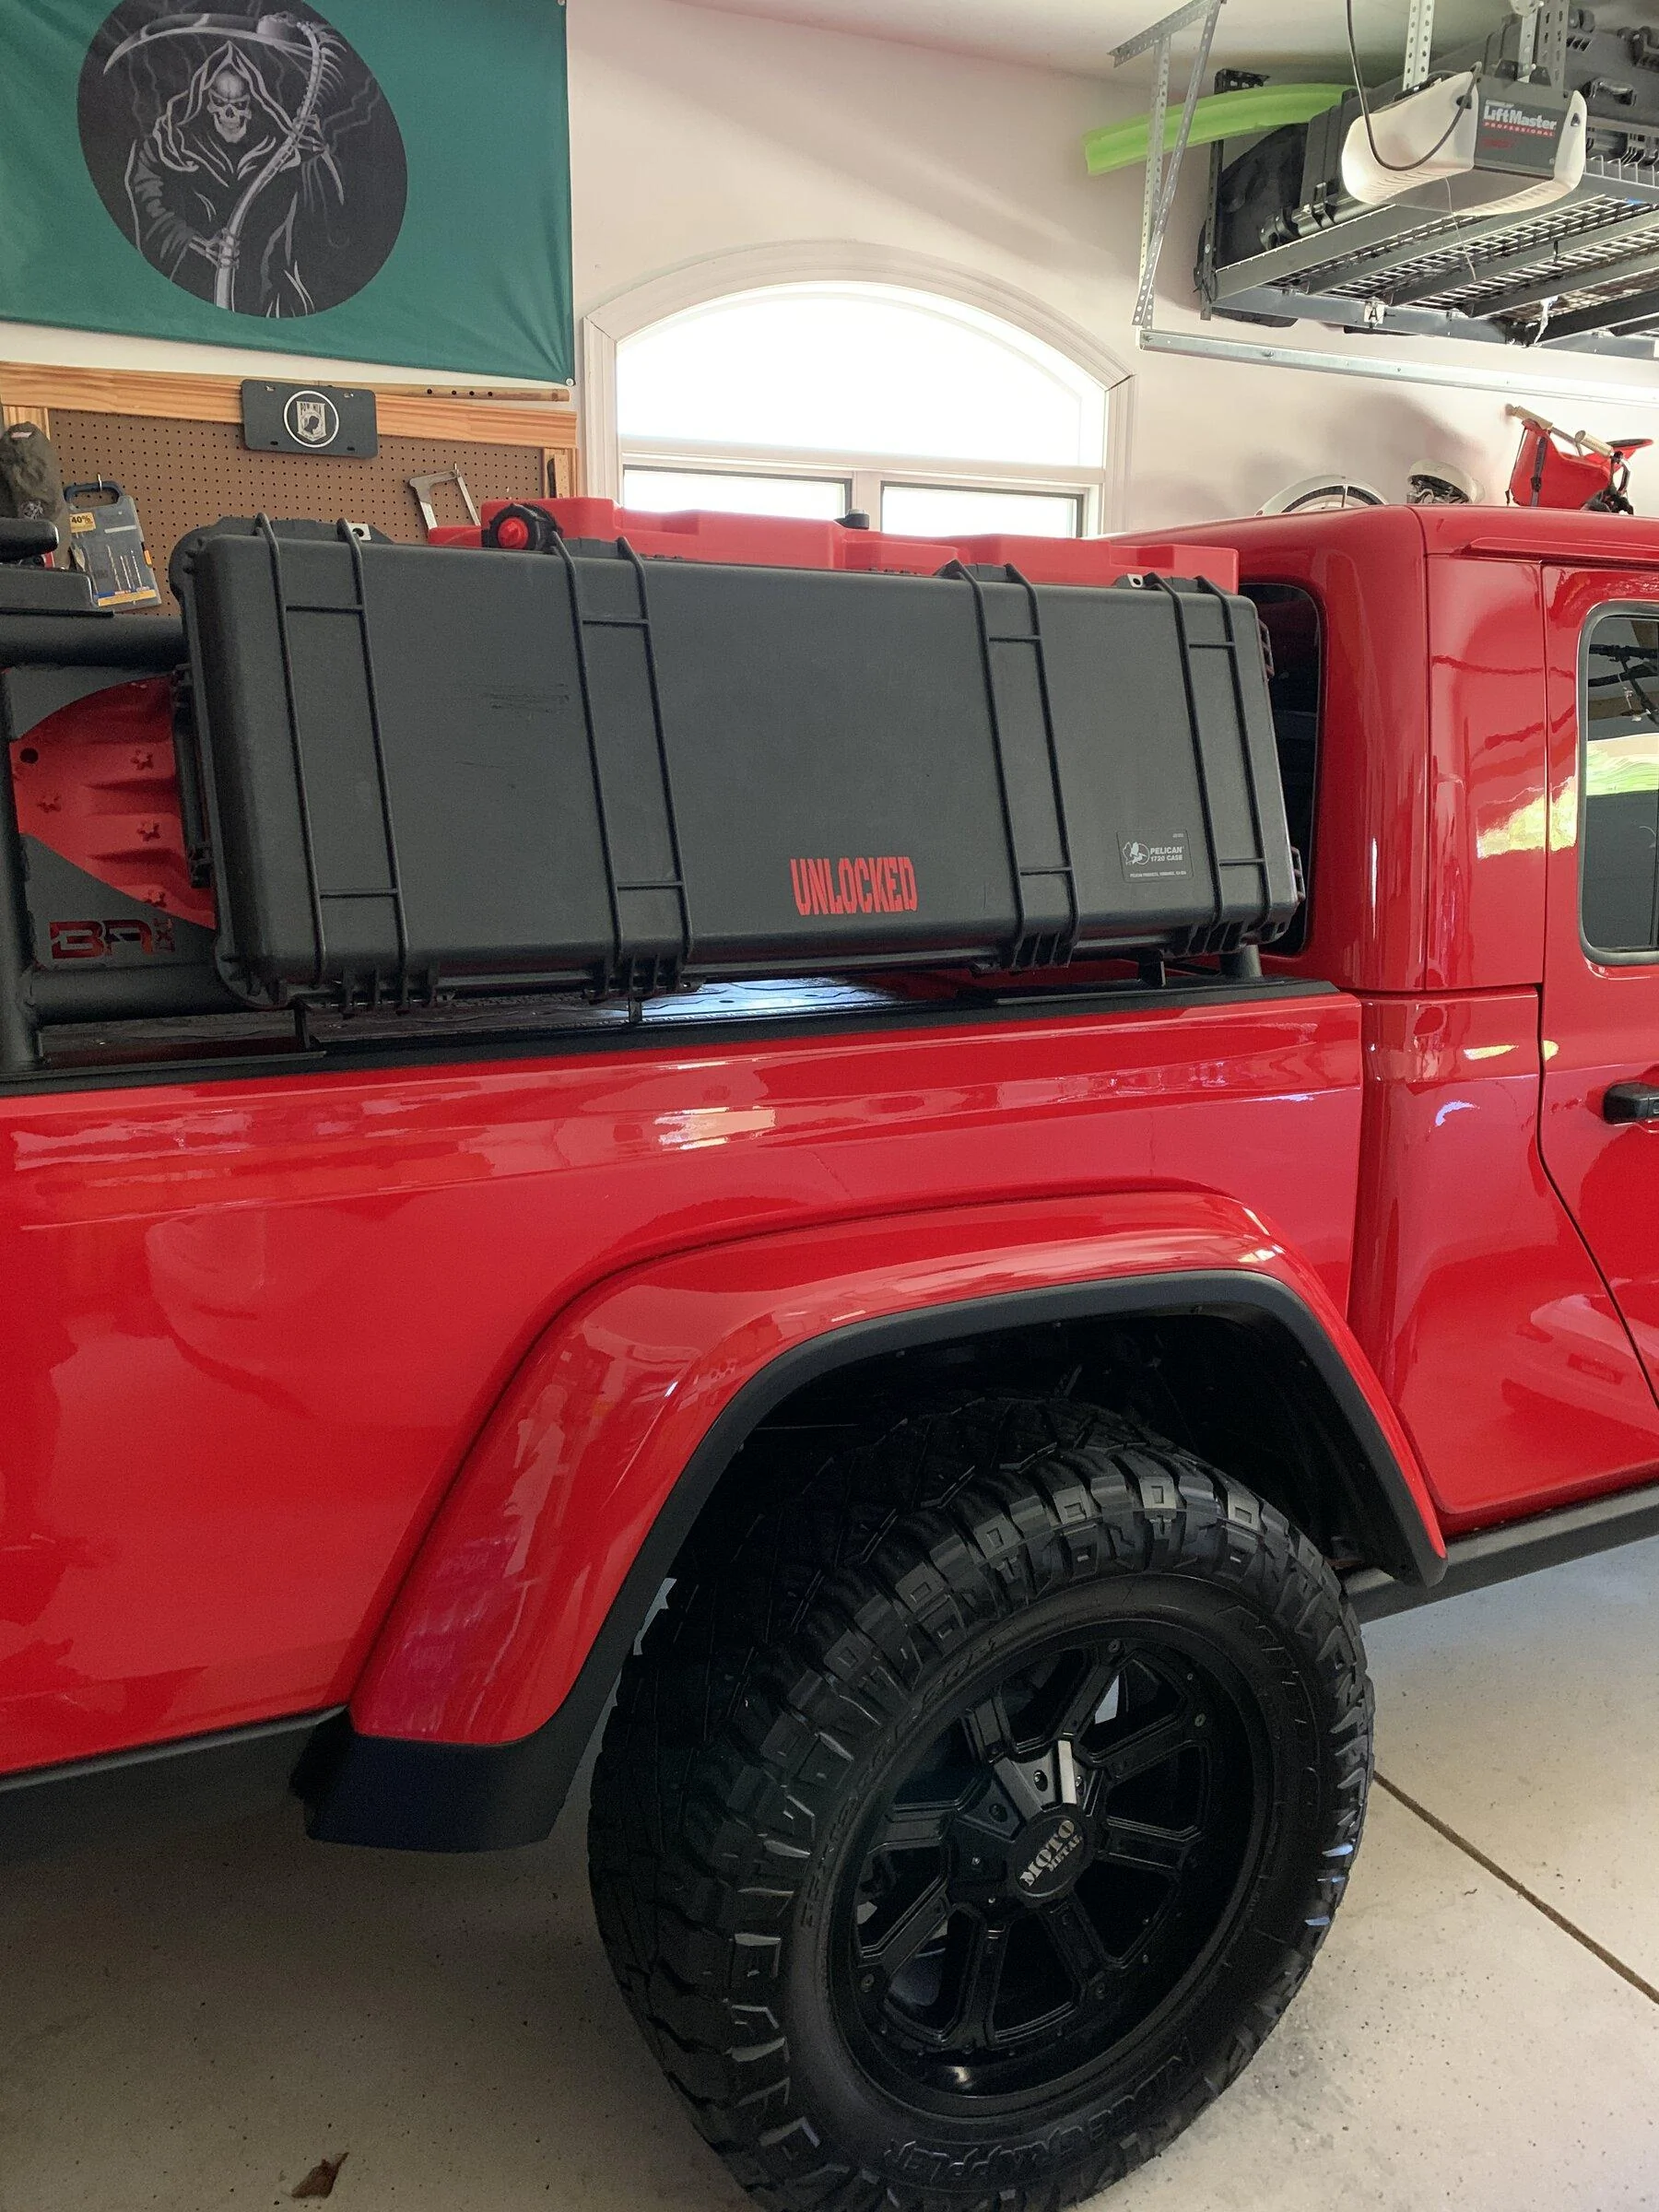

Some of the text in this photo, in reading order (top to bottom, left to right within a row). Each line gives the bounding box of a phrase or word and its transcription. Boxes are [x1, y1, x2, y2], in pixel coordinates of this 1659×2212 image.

[1484, 105, 1557, 130] LiftMaster
[1484, 122, 1553, 136] PROFESSIONAL
[71, 515, 91, 524] 40%
[1150, 846, 1182, 855] PELICAN
[790, 856, 918, 915] UNLOCKED
[1019, 1819, 1075, 1887] MOTO
[1046, 1834, 1083, 1872] METAL
